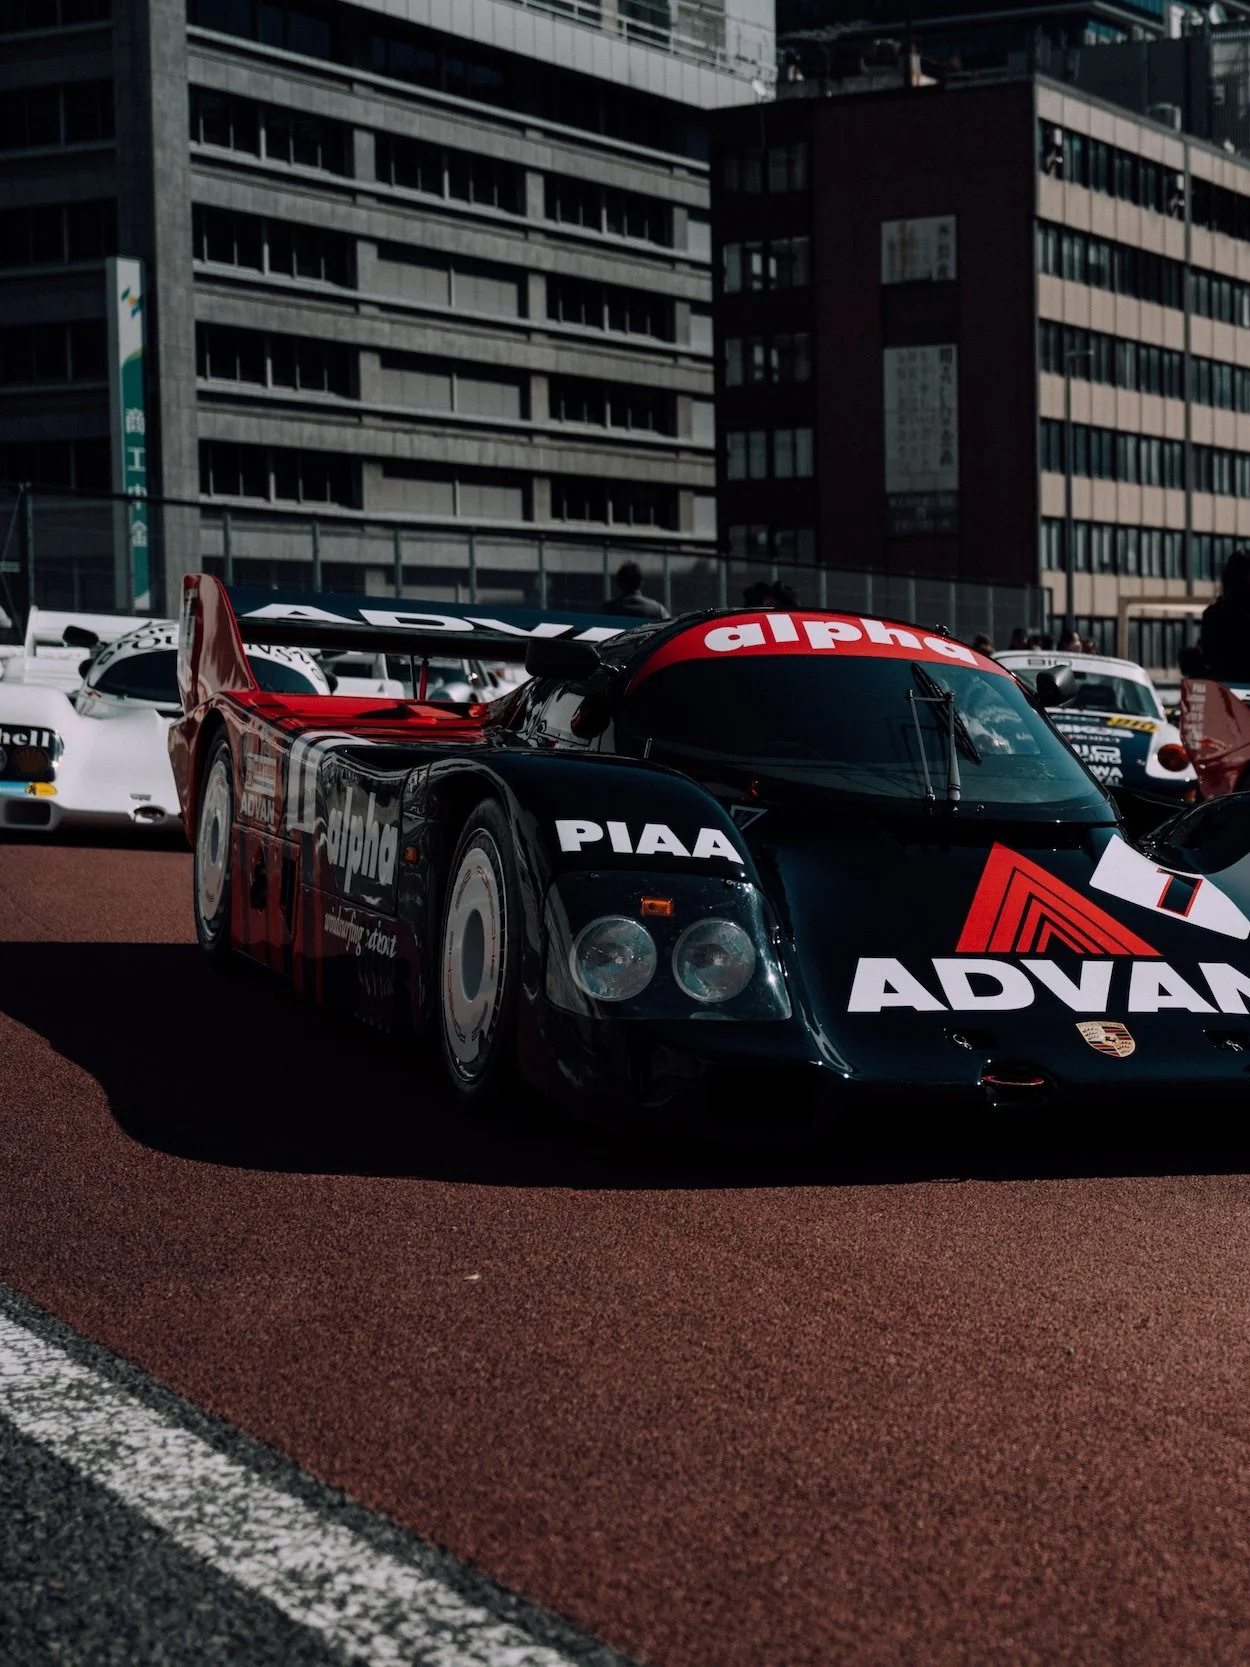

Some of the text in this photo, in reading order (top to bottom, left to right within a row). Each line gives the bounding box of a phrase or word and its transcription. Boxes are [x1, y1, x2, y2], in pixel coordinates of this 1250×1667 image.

[241, 603, 626, 643] ADV
[704, 614, 978, 665] alpha
[0, 728, 50, 748] hell
[240, 791, 275, 825] ADVAN
[327, 786, 398, 894] alpha
[555, 819, 744, 865] PIAA
